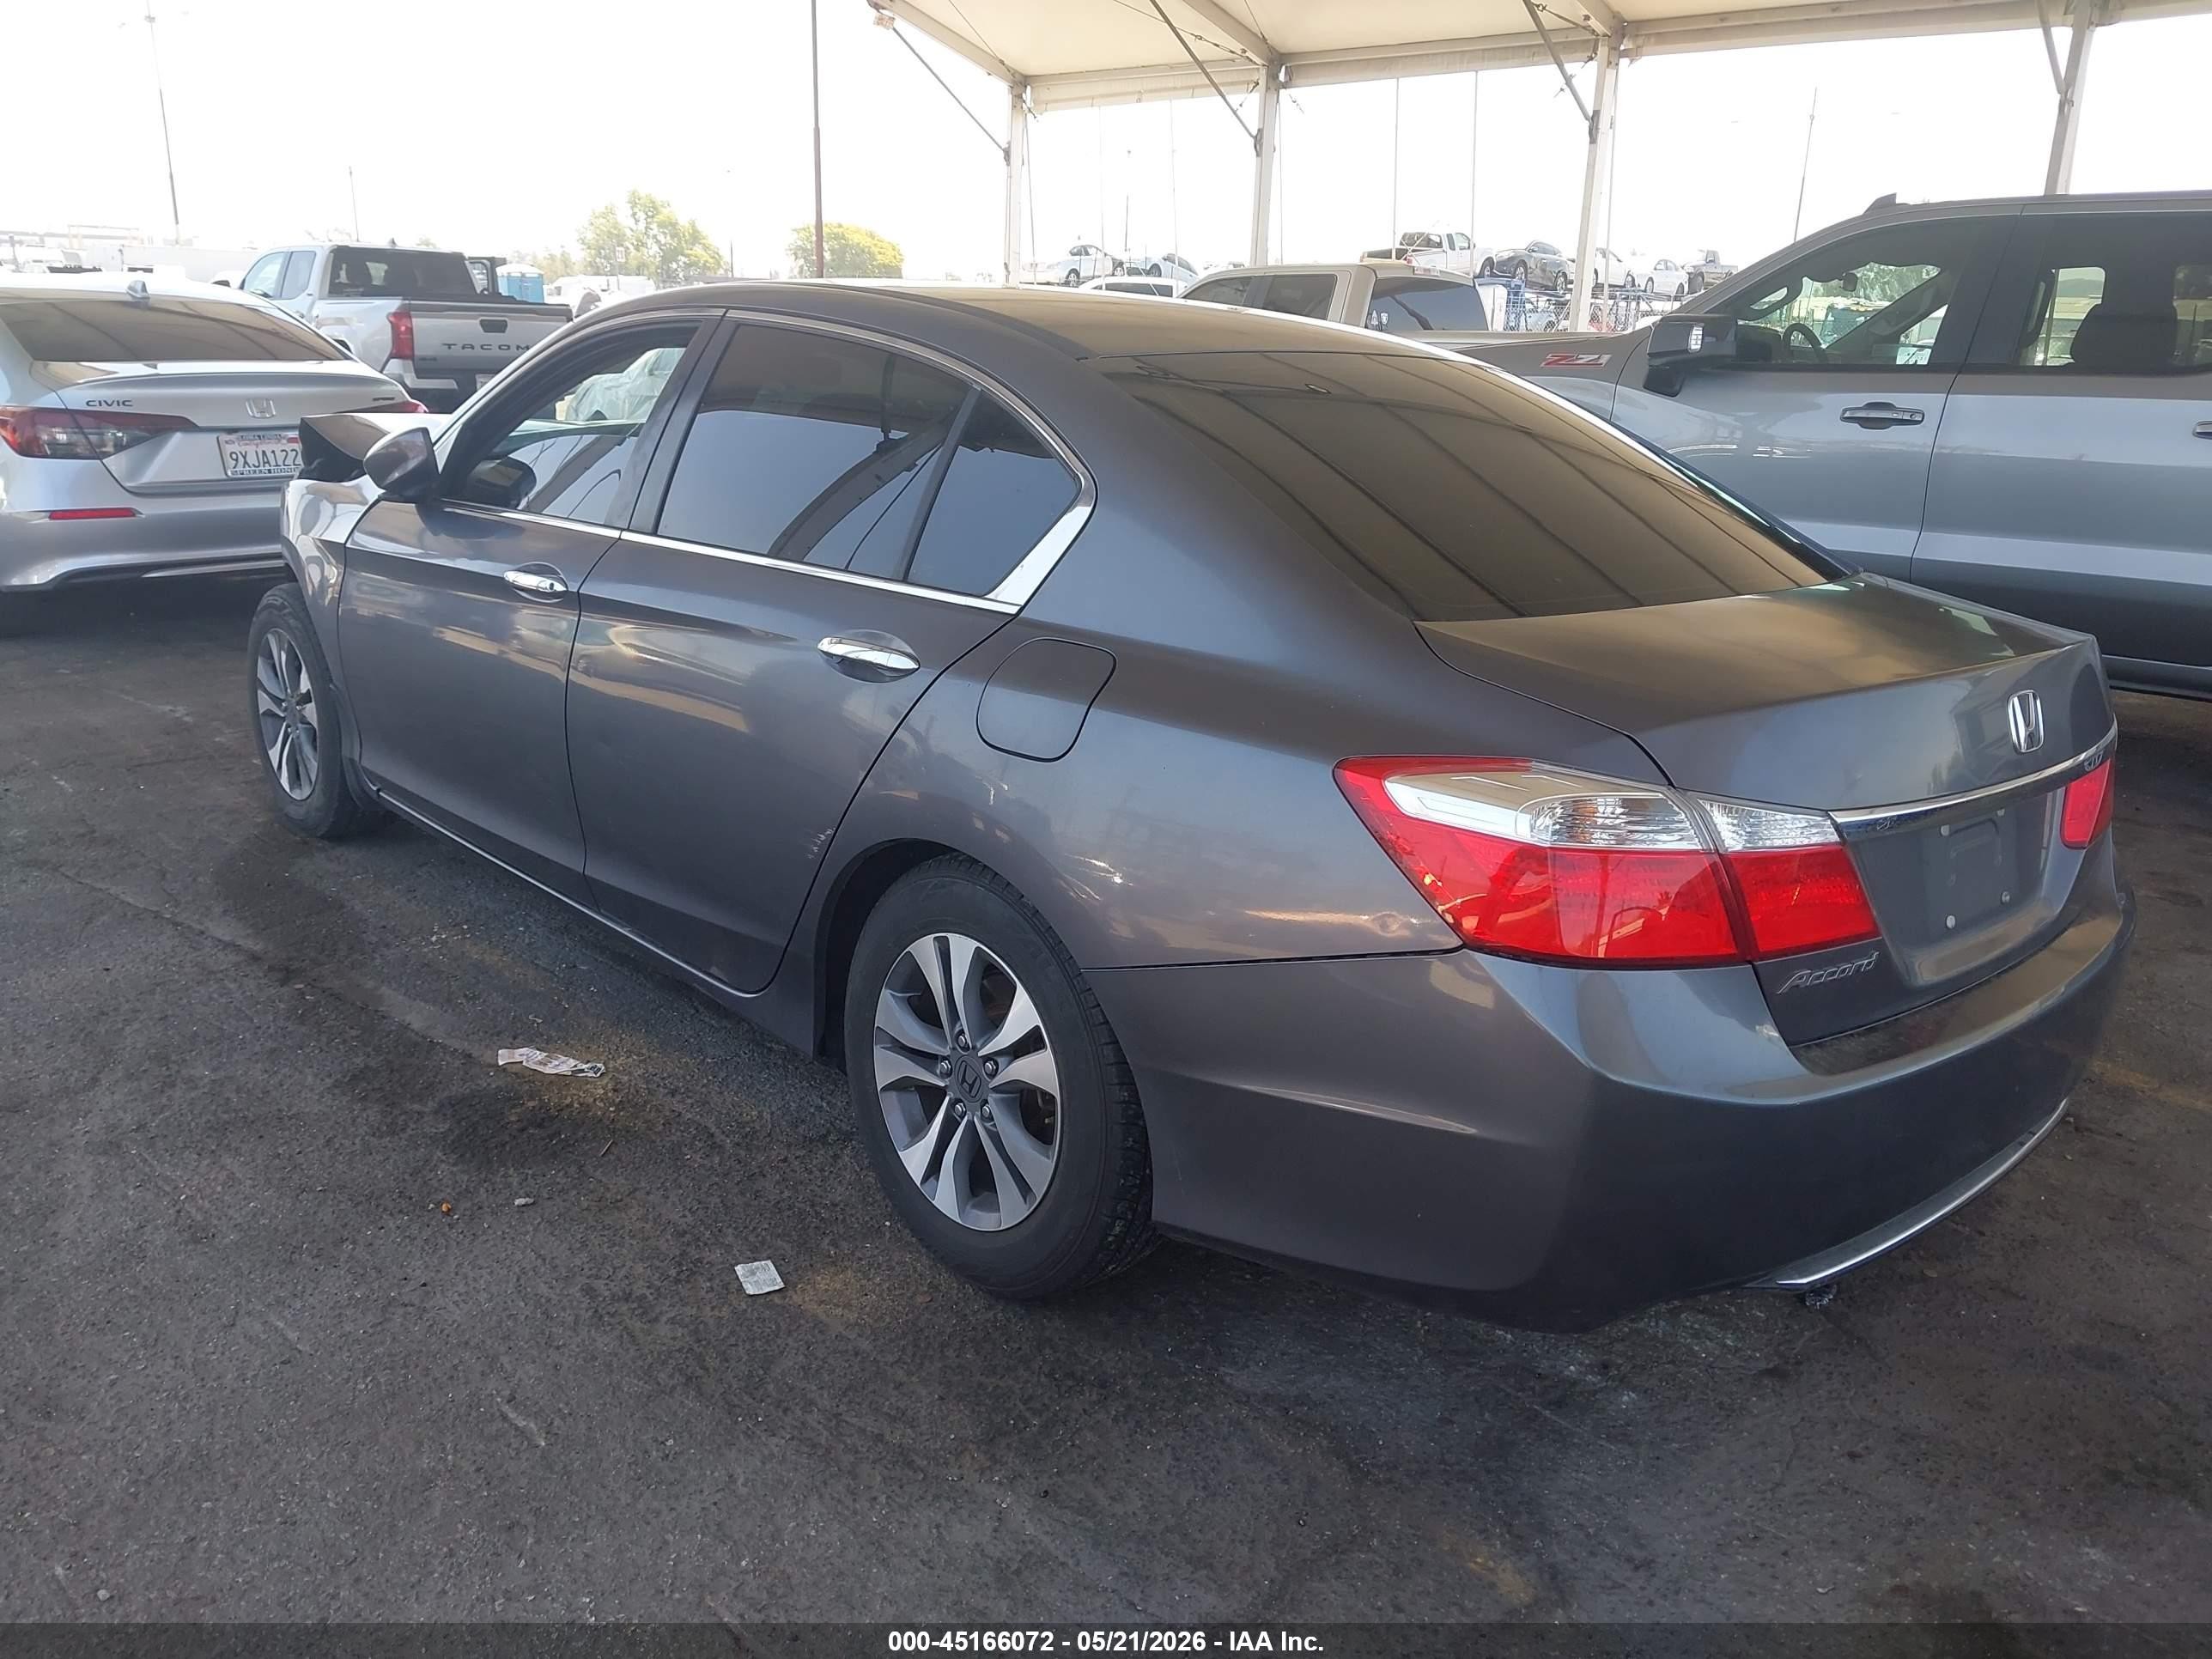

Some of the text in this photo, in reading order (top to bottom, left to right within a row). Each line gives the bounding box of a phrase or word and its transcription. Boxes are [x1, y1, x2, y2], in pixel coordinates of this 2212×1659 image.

[1540, 353, 1612, 368] Z71
[228, 448, 301, 470] 9XJA122
[1776, 951, 1880, 994] Accord
